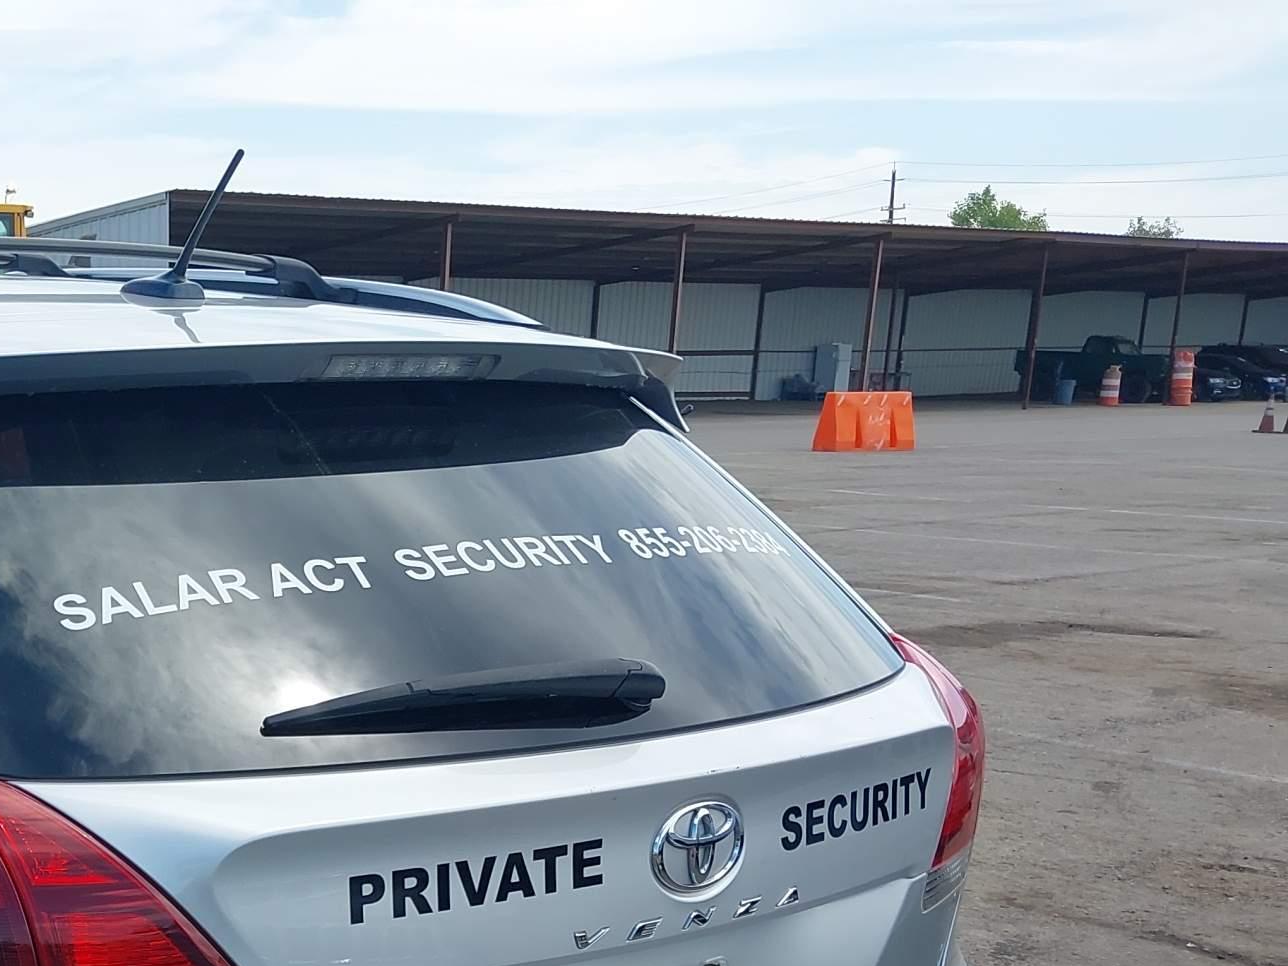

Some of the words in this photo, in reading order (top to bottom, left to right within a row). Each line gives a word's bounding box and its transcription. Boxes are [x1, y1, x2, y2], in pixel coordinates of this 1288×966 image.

[53, 568, 260, 631] SALAR
[269, 556, 372, 598] ACT
[394, 534, 614, 582] SECURITY
[348, 838, 605, 925] PRIVATE
[780, 768, 932, 851] SECURITY
[573, 886, 800, 950] VENZA
